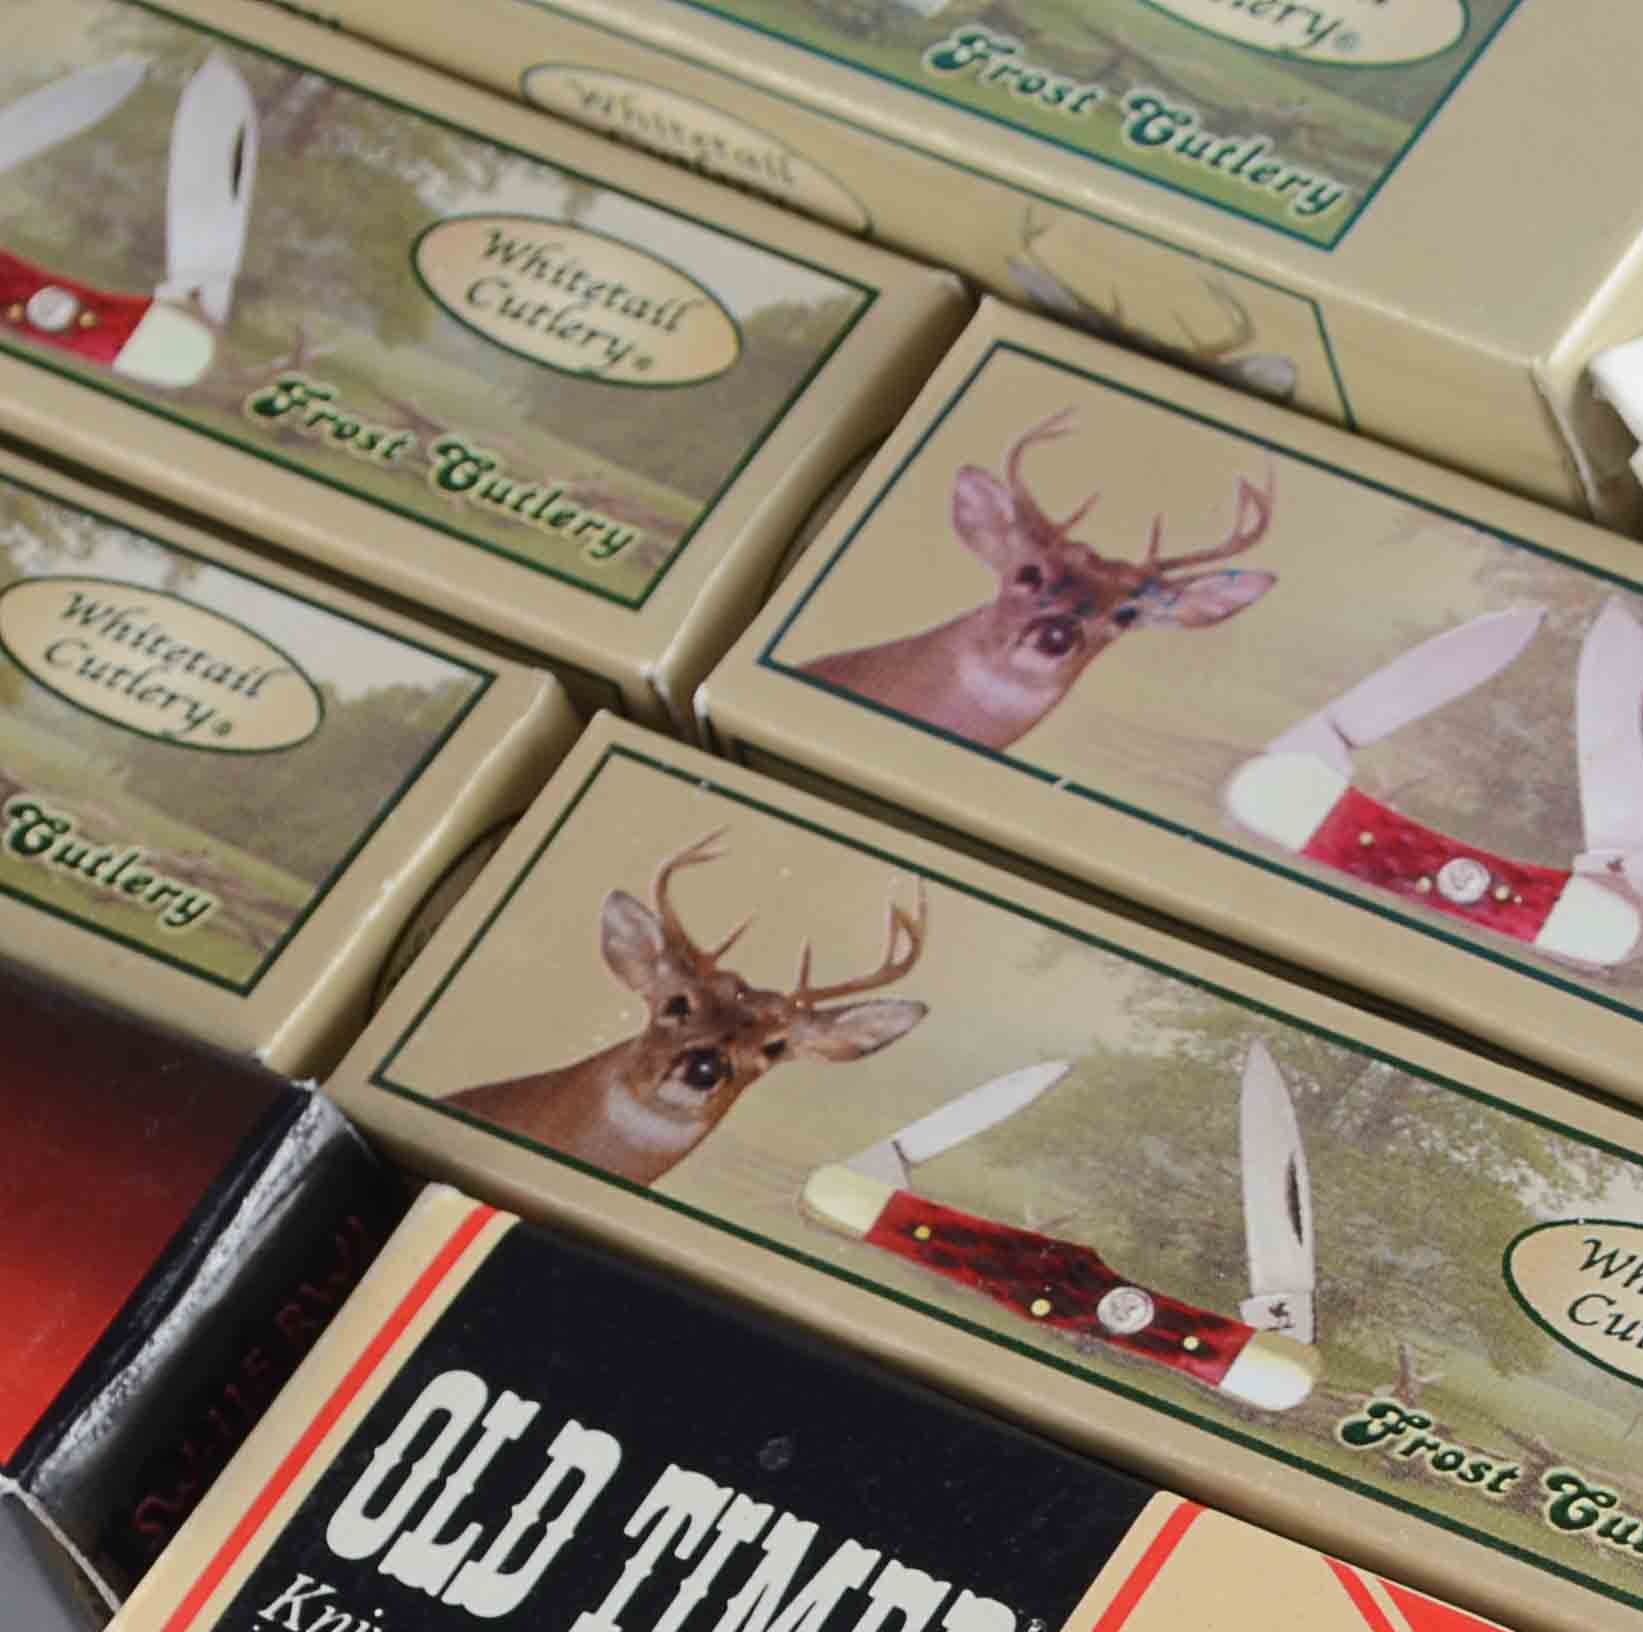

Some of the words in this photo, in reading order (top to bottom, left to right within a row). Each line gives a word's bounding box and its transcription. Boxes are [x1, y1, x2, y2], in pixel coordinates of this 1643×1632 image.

[925, 27, 1102, 116] Frost
[1123, 91, 1343, 217] Cutlery
[482, 226, 690, 336] Whitetail
[252, 376, 411, 463] Frost
[432, 435, 637, 560] Cutlery
[62, 593, 274, 700] Whitetail
[3, 802, 214, 929] Cutlery
[325, 1370, 623, 1618] OLD
[1343, 1401, 1523, 1495] Frost
